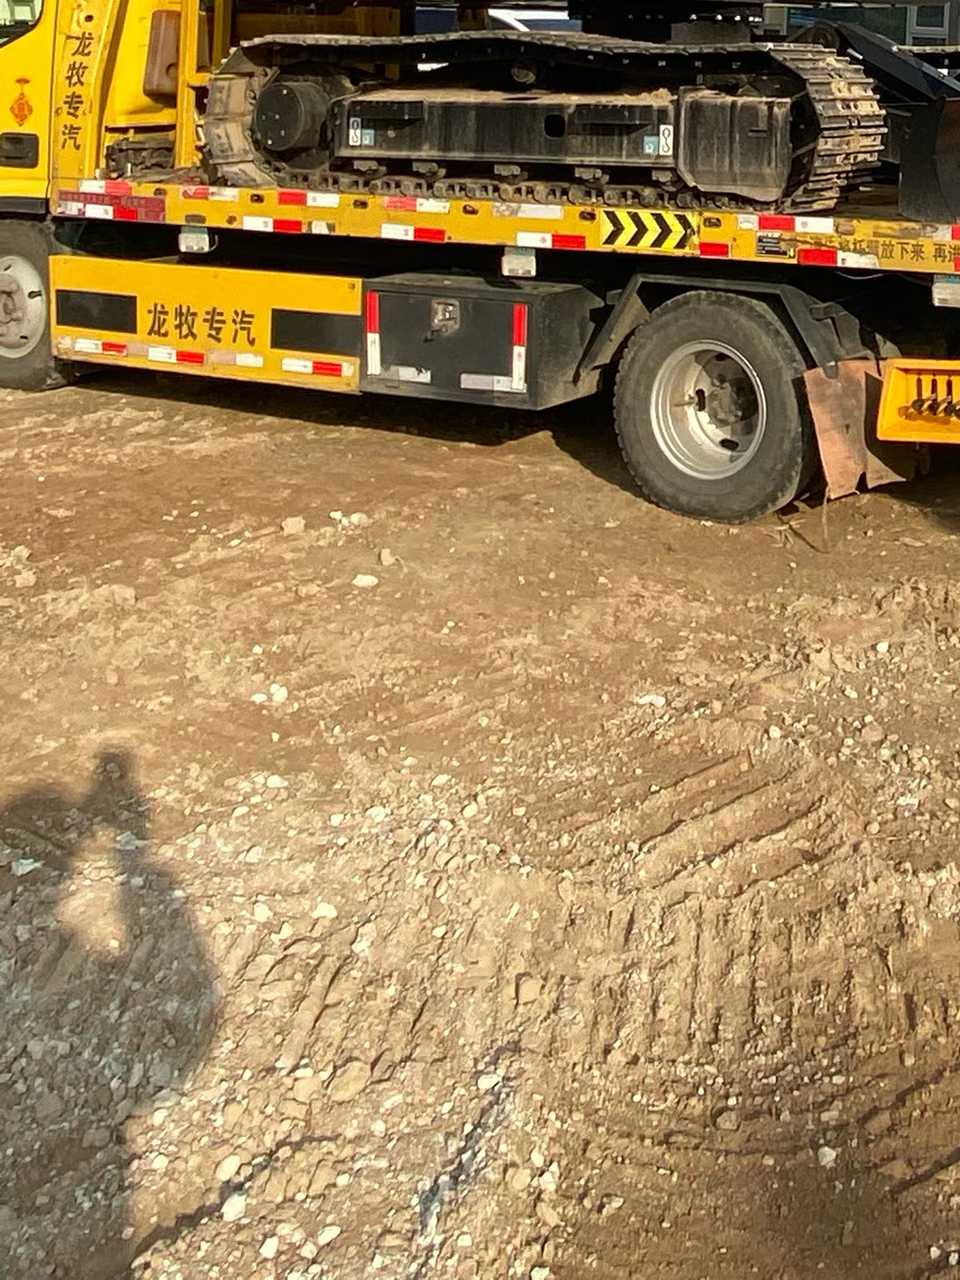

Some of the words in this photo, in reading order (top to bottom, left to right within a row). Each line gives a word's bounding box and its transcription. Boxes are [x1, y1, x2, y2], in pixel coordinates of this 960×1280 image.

[61, 31, 94, 151] 龙牧专汽
[147, 302, 256, 347] 龙牧专汽
